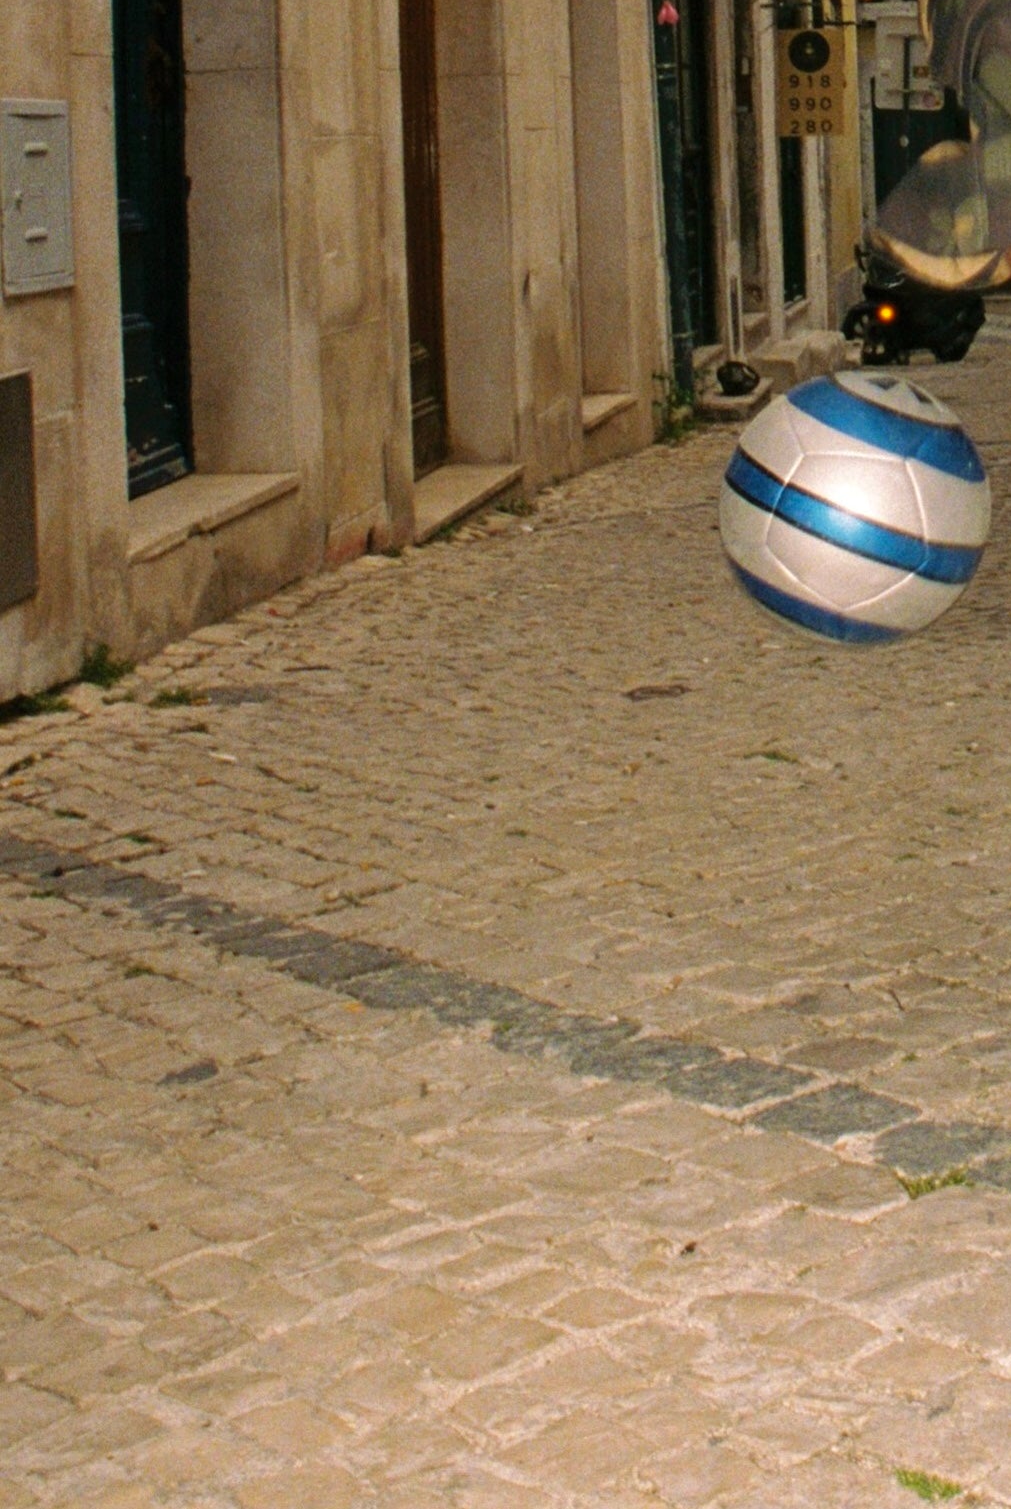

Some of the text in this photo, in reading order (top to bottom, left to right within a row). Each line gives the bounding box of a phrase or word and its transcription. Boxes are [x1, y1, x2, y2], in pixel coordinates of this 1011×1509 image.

[788, 74, 831, 89] 918
[788, 97, 832, 112] 990
[791, 119, 833, 134] 280
